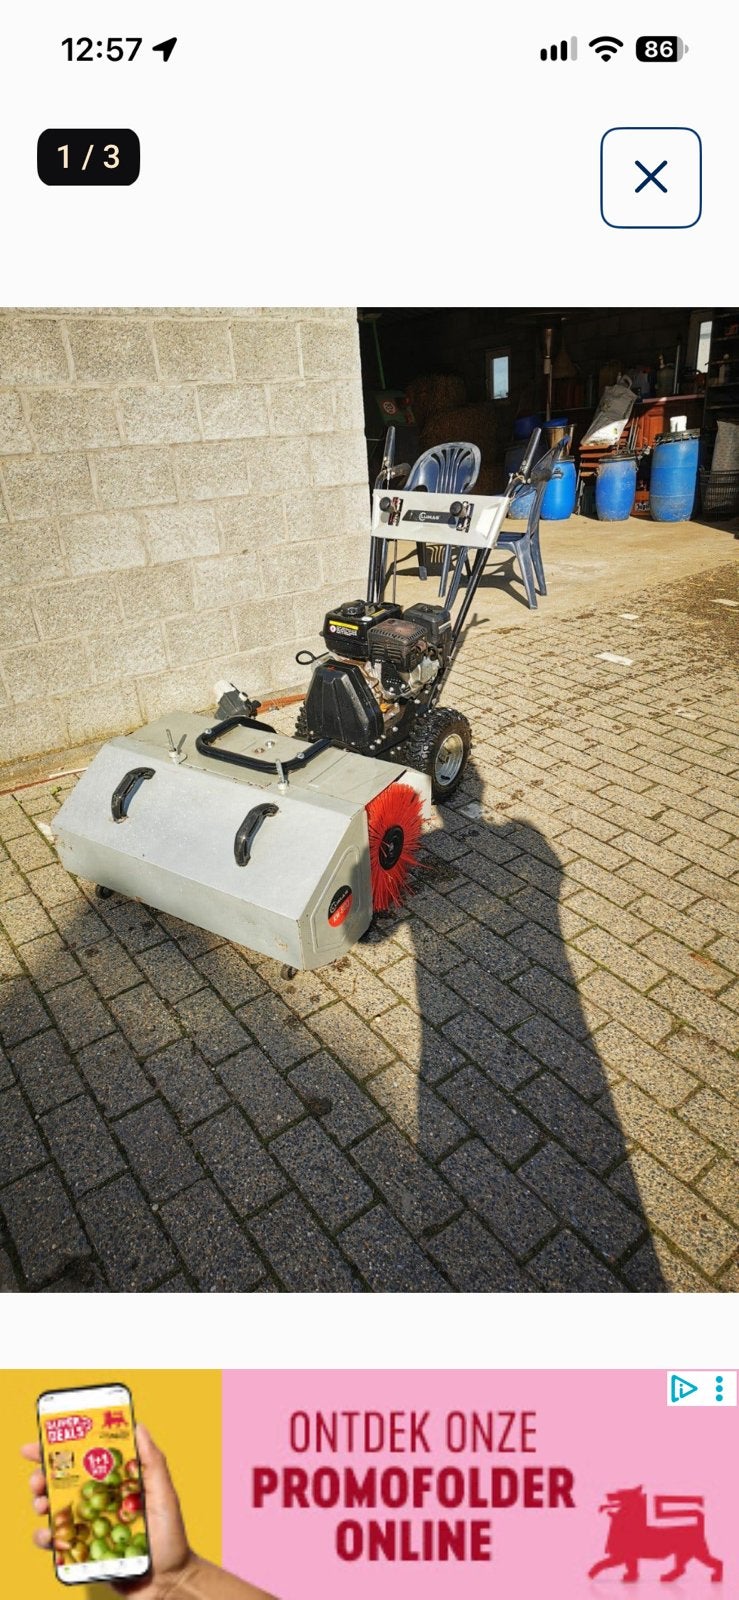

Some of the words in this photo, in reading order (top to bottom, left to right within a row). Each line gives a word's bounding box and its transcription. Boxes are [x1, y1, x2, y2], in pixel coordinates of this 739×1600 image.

[61, 36, 143, 62] 12:57
[644, 40, 674, 58] 86
[57, 144, 69, 169] 1
[103, 144, 120, 169] 3
[48, 1426, 84, 1442] DEALS
[289, 1410, 431, 1454] ONTDEK
[446, 1410, 537, 1454] ONZE
[87, 1453, 109, 1468] 1+1
[252, 1465, 576, 1509] PROMOFOLDER
[335, 1518, 492, 1562] ONLINE
